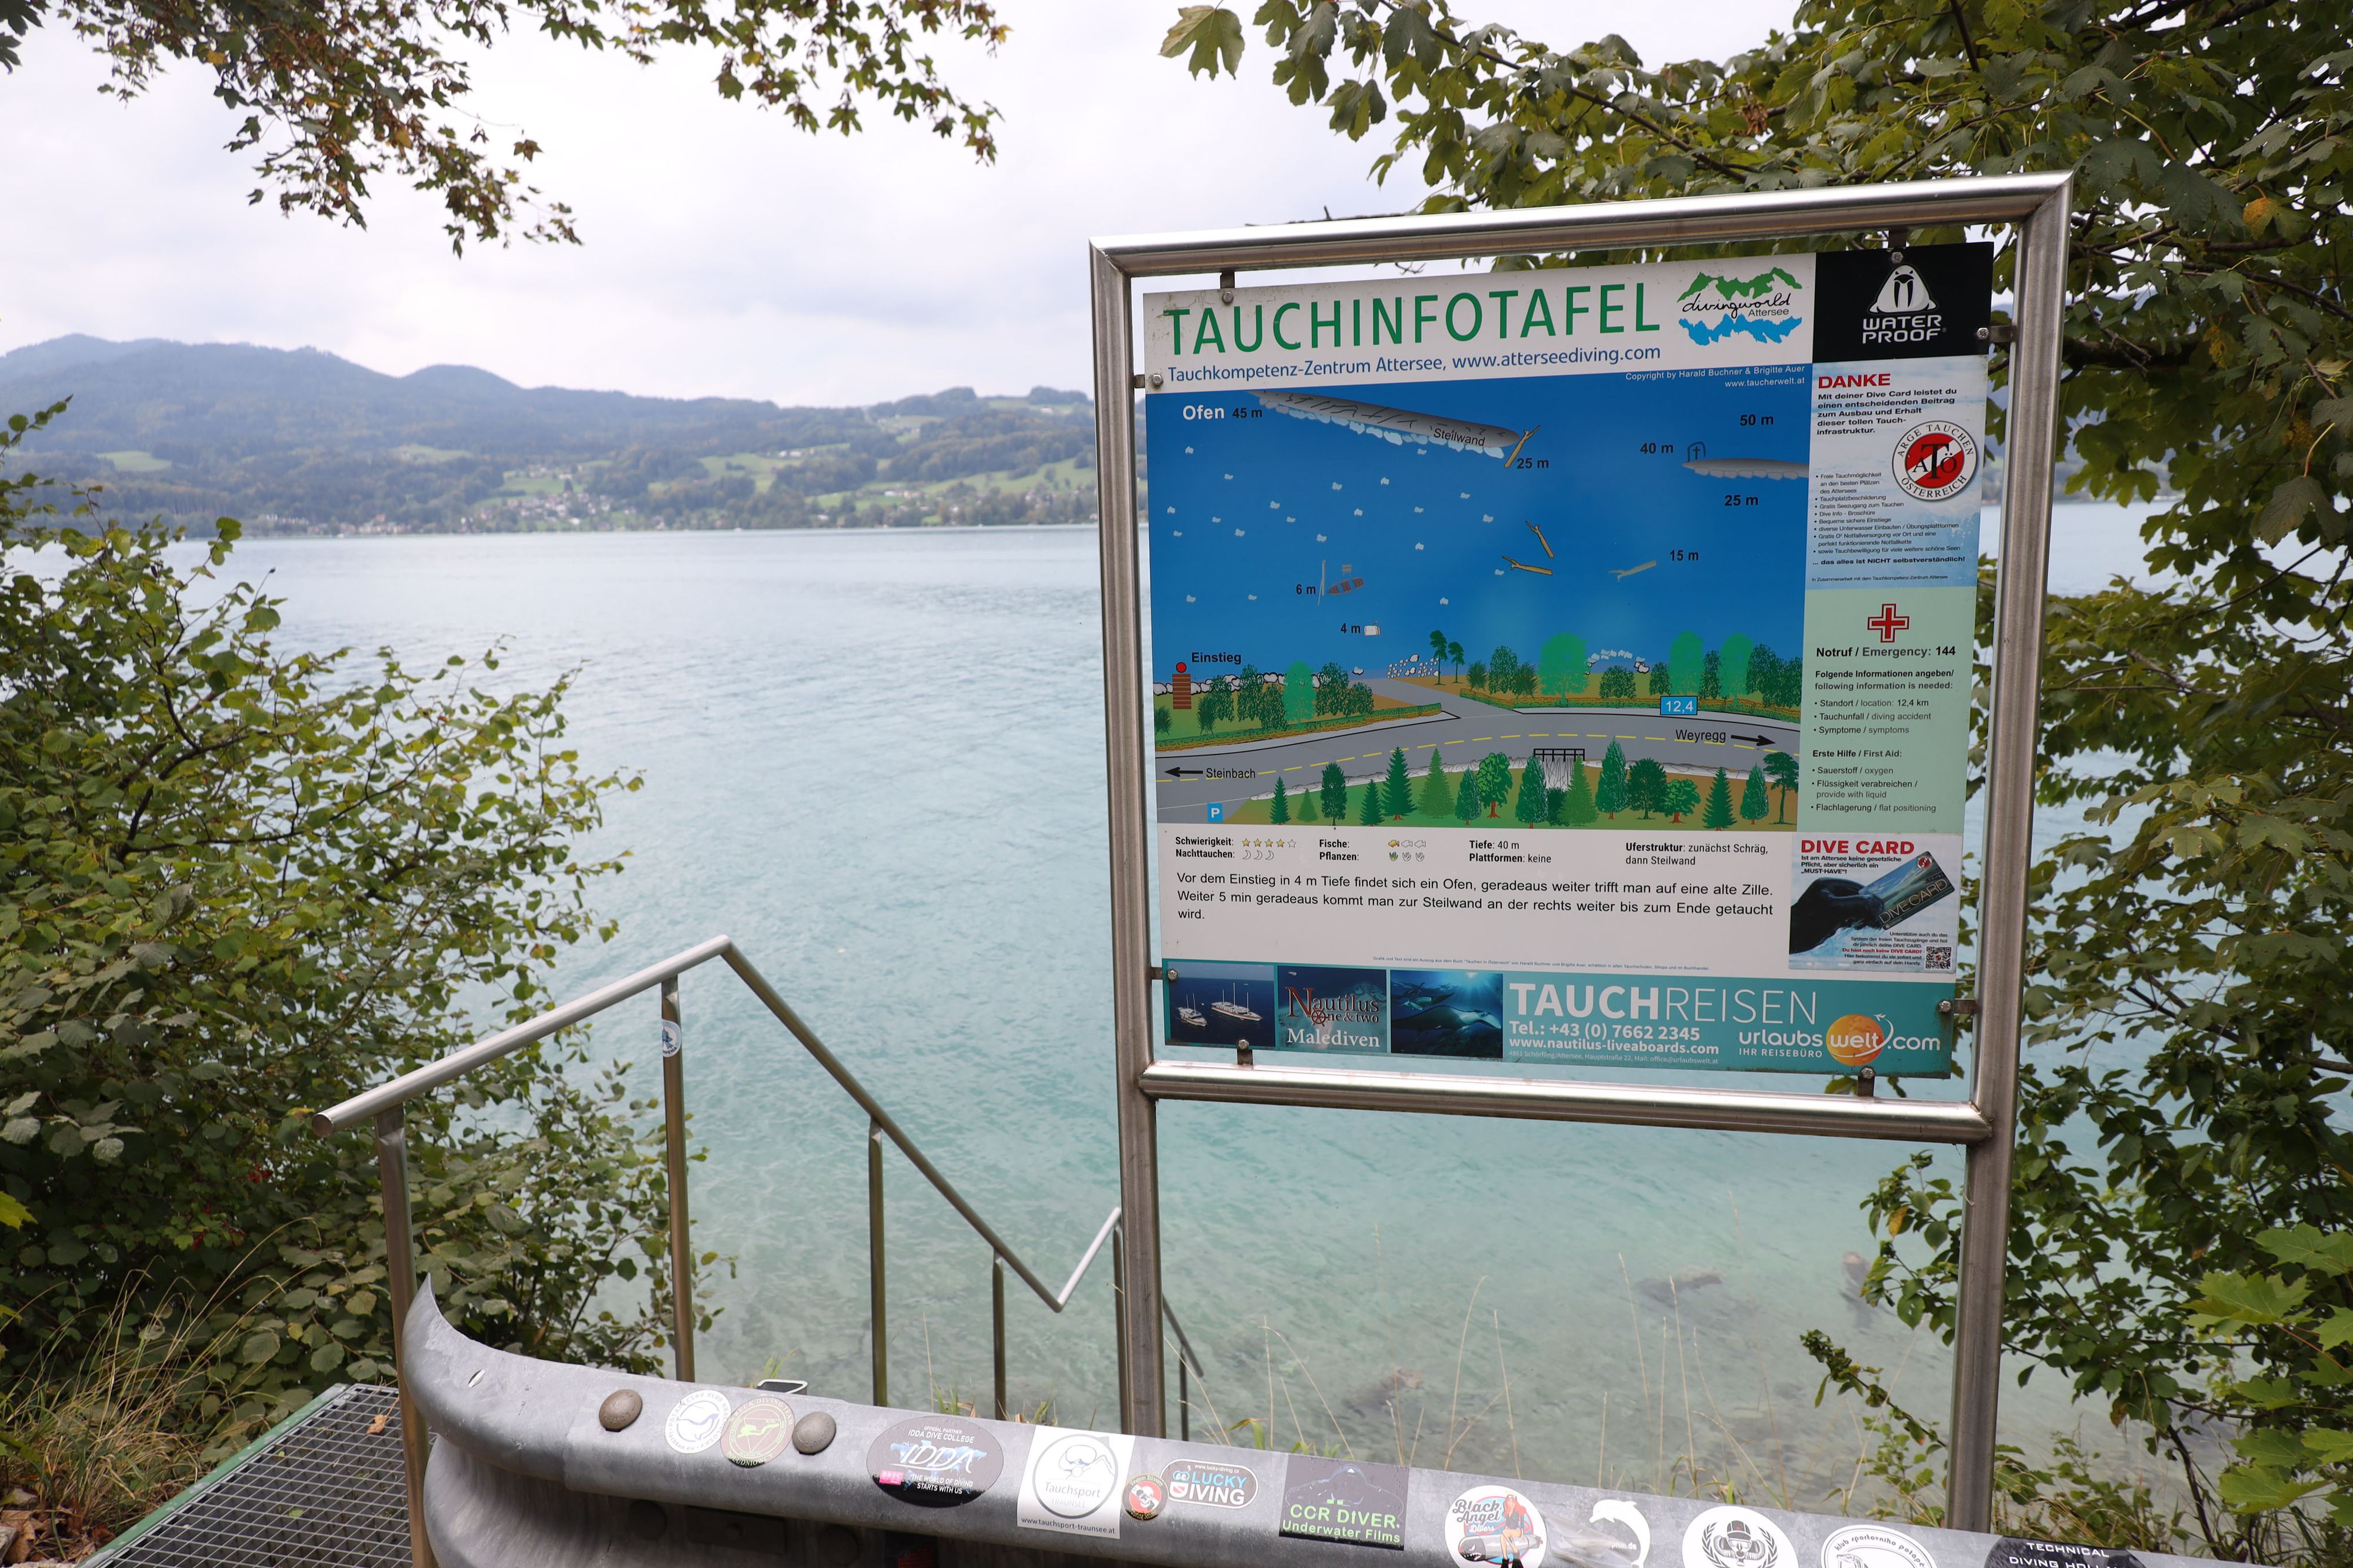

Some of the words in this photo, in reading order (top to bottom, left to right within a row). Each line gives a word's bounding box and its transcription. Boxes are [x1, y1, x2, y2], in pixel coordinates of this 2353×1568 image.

[1682, 292, 1790, 319] divingworld
[1748, 307, 1789, 317] Attersee
[1164, 282, 1660, 355] TAUCHINFOTAFEL
[1863, 315, 1941, 331] WATER
[1862, 328, 1940, 343] PROOF
[1168, 358, 1371, 382] Tauchkompetenz-Zentrum
[1376, 356, 1447, 373] Attersee,
[1452, 346, 1660, 369] www.atterseediving.com
[1625, 373, 1664, 381] Copyright
[1679, 369, 1705, 378] Harald
[1754, 366, 1782, 375] Brigitte
[1725, 377, 1805, 387] www.taucherwelt.at
[1818, 373, 1891, 389] DANKE
[1845, 399, 1918, 408] entscheidenden
[1921, 397, 1955, 405] Beitrag
[1182, 404, 1225, 421] Ofen
[1232, 408, 1248, 419] 45
[1251, 409, 1262, 418] m
[1739, 414, 1758, 426] 50
[1761, 416, 1774, 425] m
[1433, 426, 1485, 446] Steilwand
[1817, 427, 1875, 435] infrastruktur.
[1898, 429, 1921, 457] ARGE
[1926, 424, 1974, 455] TAUCHEN
[1640, 443, 1659, 454] 40
[1662, 445, 1674, 453] m
[1517, 458, 1535, 469] 25
[1901, 475, 1967, 498] ÖSTERREICH
[1724, 495, 1741, 506] 25
[1743, 497, 1758, 505] m
[1669, 551, 1685, 561] 15
[1296, 584, 1303, 595] 6
[1340, 623, 1348, 634] 4
[1191, 652, 1242, 665] Einstieg
[1816, 647, 1852, 657] Notruf
[1862, 646, 1931, 658] Emergency:
[1936, 646, 1956, 655] 144
[1665, 700, 1694, 714] 12,4
[1897, 699, 1914, 708] 12,4
[1676, 730, 1726, 742] Weyregg
[1206, 768, 1256, 779] Steinbach
[1211, 808, 1220, 818] P
[1175, 837, 1234, 848] Schwierigkeit:
[1319, 839, 1349, 848] Fische:
[1469, 840, 1495, 849] Tiefe:
[1626, 843, 1685, 852] Uferstruktur:
[1688, 843, 1731, 852] zunächst
[1734, 844, 1768, 855] Schräg,
[1801, 840, 1849, 853] DIVE
[1856, 841, 1915, 854] CARD
[1176, 849, 1235, 858] Nachttauchen:
[1319, 852, 1359, 861] Pflanzen:
[1469, 853, 1525, 862] Plattformen:
[1528, 854, 1551, 863] keine
[1625, 856, 1648, 865] dann
[1651, 856, 1695, 865] Steilwand
[1176, 873, 1197, 883] Vor
[1200, 873, 1225, 883] dem
[1230, 874, 1275, 887] Einstieg
[1280, 875, 1290, 885] in
[1294, 875, 1301, 885] 4
[1321, 876, 1350, 886] Tiefe
[1354, 878, 1387, 888] findet
[1392, 878, 1416, 888] sich
[1420, 879, 1438, 889] ein
[1443, 879, 1476, 892] Ofen,
[1481, 880, 1548, 892] geradeaus
[1552, 882, 1589, 893] weiter
[1595, 882, 1618, 893] trifft
[1656, 883, 1677, 893] auf
[1681, 883, 1708, 894] eine
[1713, 884, 1737, 895] alte
[1742, 885, 1773, 895] Zille.
[1879, 900, 1911, 923] DIVE
[1909, 879, 1948, 905] CARD
[1286, 987, 1379, 1017] Nautilus
[1509, 983, 1817, 1026] TAUCHREISEN
[1343, 1012, 1353, 1022] &
[1355, 1013, 1379, 1023] two
[1509, 1021, 1545, 1035] Tel.:
[1549, 1023, 1579, 1036] +43
[1585, 1023, 1607, 1040] (0)
[1612, 1025, 1654, 1039] 7662
[1658, 1026, 1700, 1040] 2345
[1287, 1028, 1380, 1047] Malediven
[1509, 1037, 1719, 1054] www.nautilus-liveaboards.com
[1761, 1047, 1822, 1058] REISEBÜRO
[908, 1429, 924, 1437] IDDA
[943, 1433, 974, 1443] COLLEGE
[917, 1483, 938, 1491] STARTS
[1192, 1472, 1247, 1489] LUCKY
[1045, 1482, 1101, 1498] Tauchsport
[1452, 1499, 1501, 1513] Black
[1290, 1504, 1330, 1522] CCR
[1457, 1510, 1500, 1525] Angel
[1022, 1517, 1115, 1534] www.tauchsport-traunsee.at
[1282, 1520, 1361, 1538] Underwater
[1365, 1529, 1400, 1543] Films
[1835, 1540, 1849, 1550] klub
[2027, 1542, 2109, 1557] TECHNICAL
[2009, 1556, 2058, 1568] DIVING
